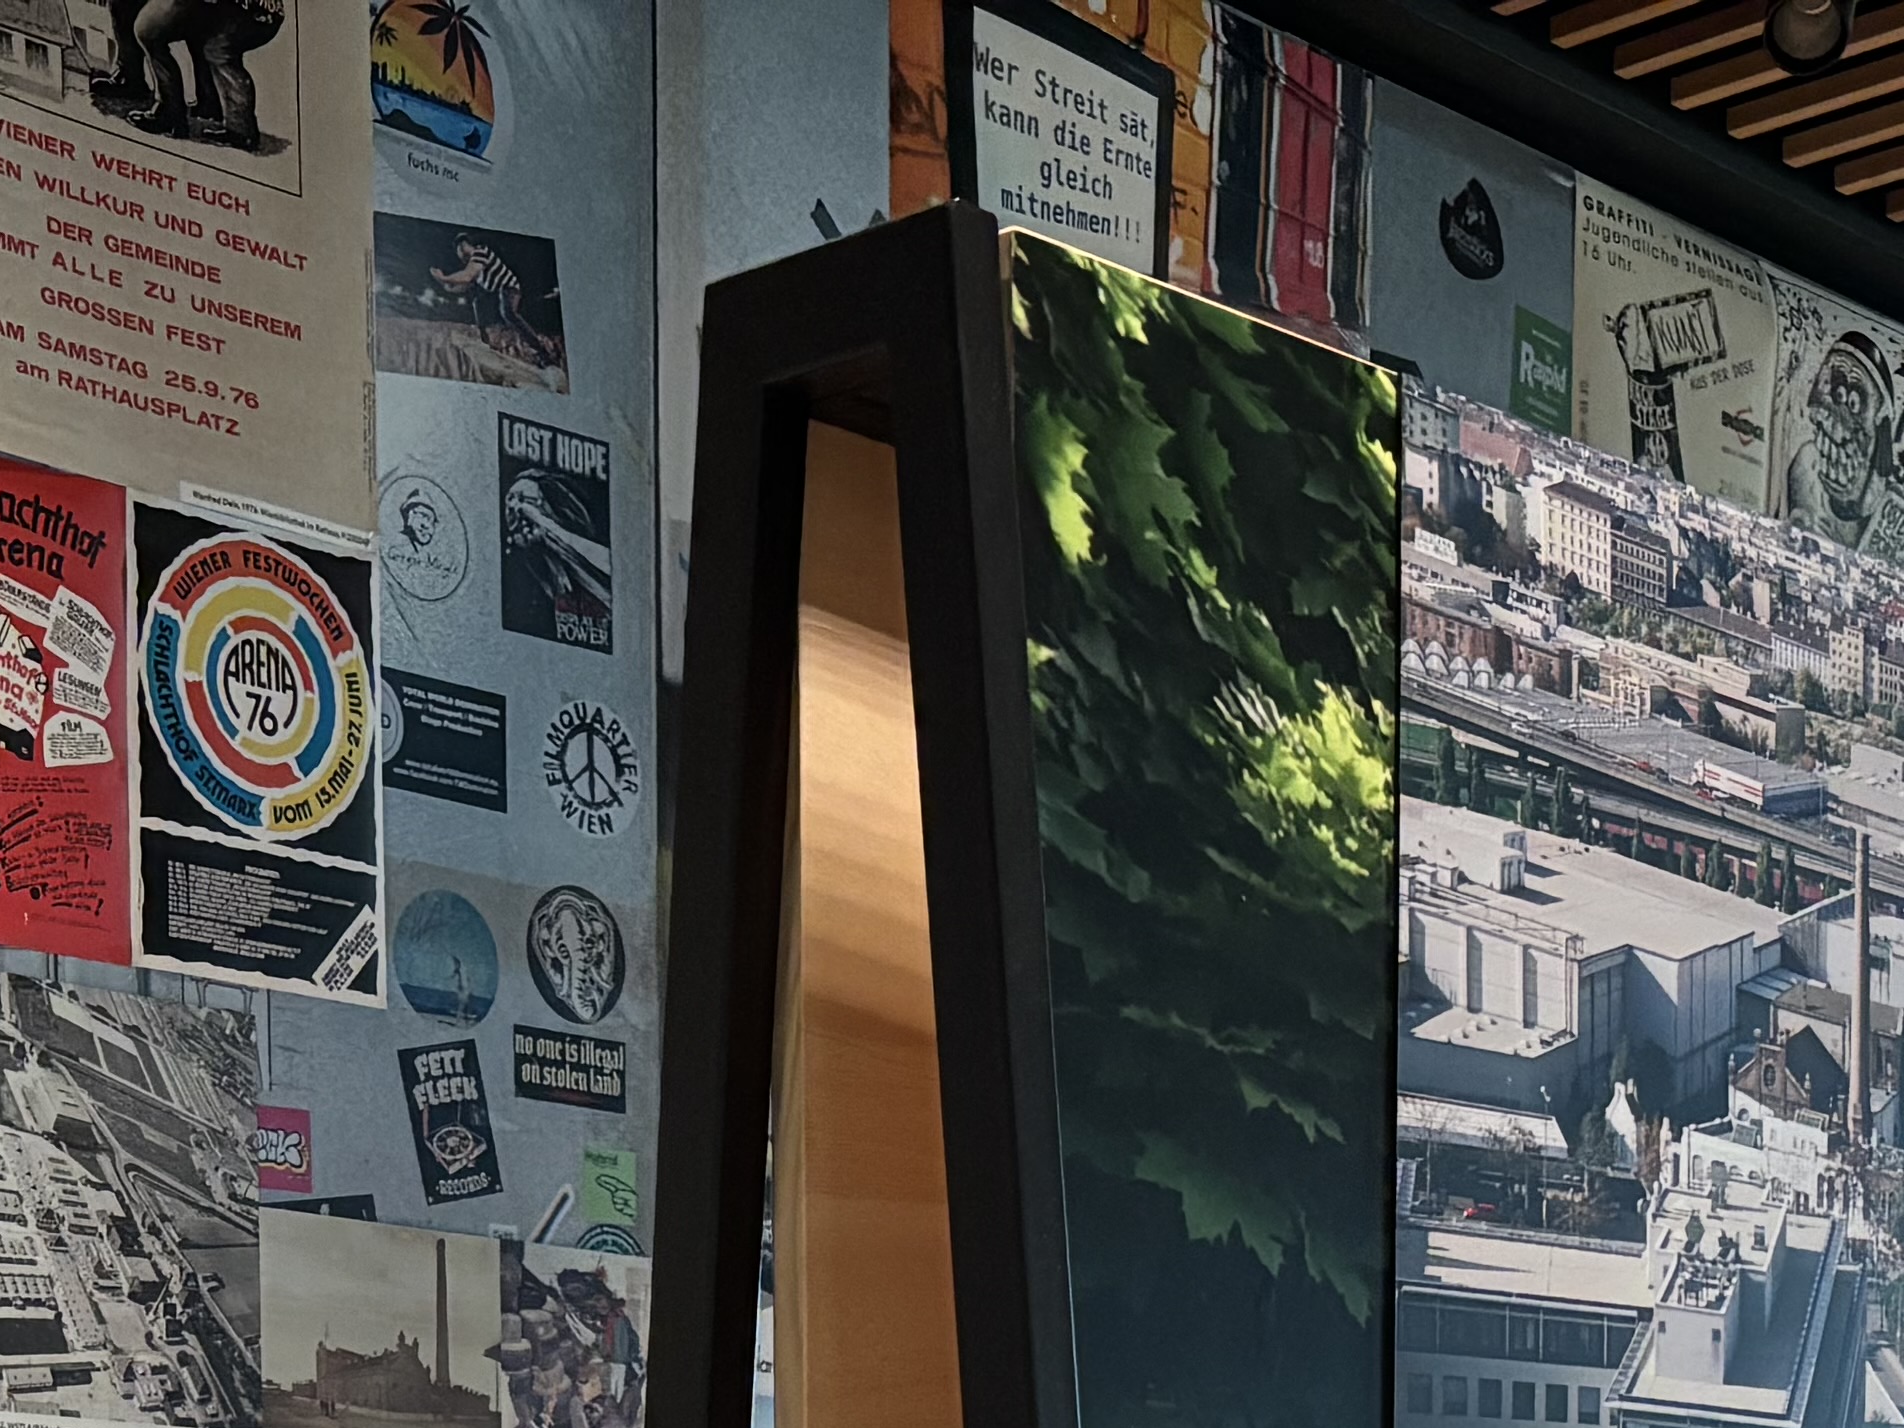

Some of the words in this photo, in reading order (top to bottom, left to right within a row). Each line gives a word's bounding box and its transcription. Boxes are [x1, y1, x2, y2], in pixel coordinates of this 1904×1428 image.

[972, 41, 1020, 86] Wer
[1034, 68, 1108, 125] Streit
[1119, 110, 1155, 149] sät,
[983, 89, 1040, 139] kann
[1053, 119, 1091, 156] die
[1102, 136, 1153, 179] Ernte
[90, 150, 178, 193] WEHRT
[186, 181, 251, 217] EUCH
[1039, 157, 1113, 201] gleich
[1000, 188, 1140, 244] mitnehmen!!!
[1582, 195, 1655, 239] GRAFFITI
[40, 286, 154, 336] GROSSEN
[165, 324, 227, 356] FEST
[15, 359, 50, 383] am
[57, 368, 241, 437] RATHAUSPLATZ
[172, 549, 231, 601] WIENER
[242, 549, 344, 642] FESTWOCHEN
[224, 638, 297, 696] ARENA
[246, 691, 279, 737] 76
[413, 1048, 465, 1082] FETT
[512, 1031, 534, 1061] no
[536, 1037, 563, 1061] one
[564, 1036, 579, 1063] is
[412, 1076, 479, 1111] FLECK
[435, 1171, 492, 1196] RECORDS
